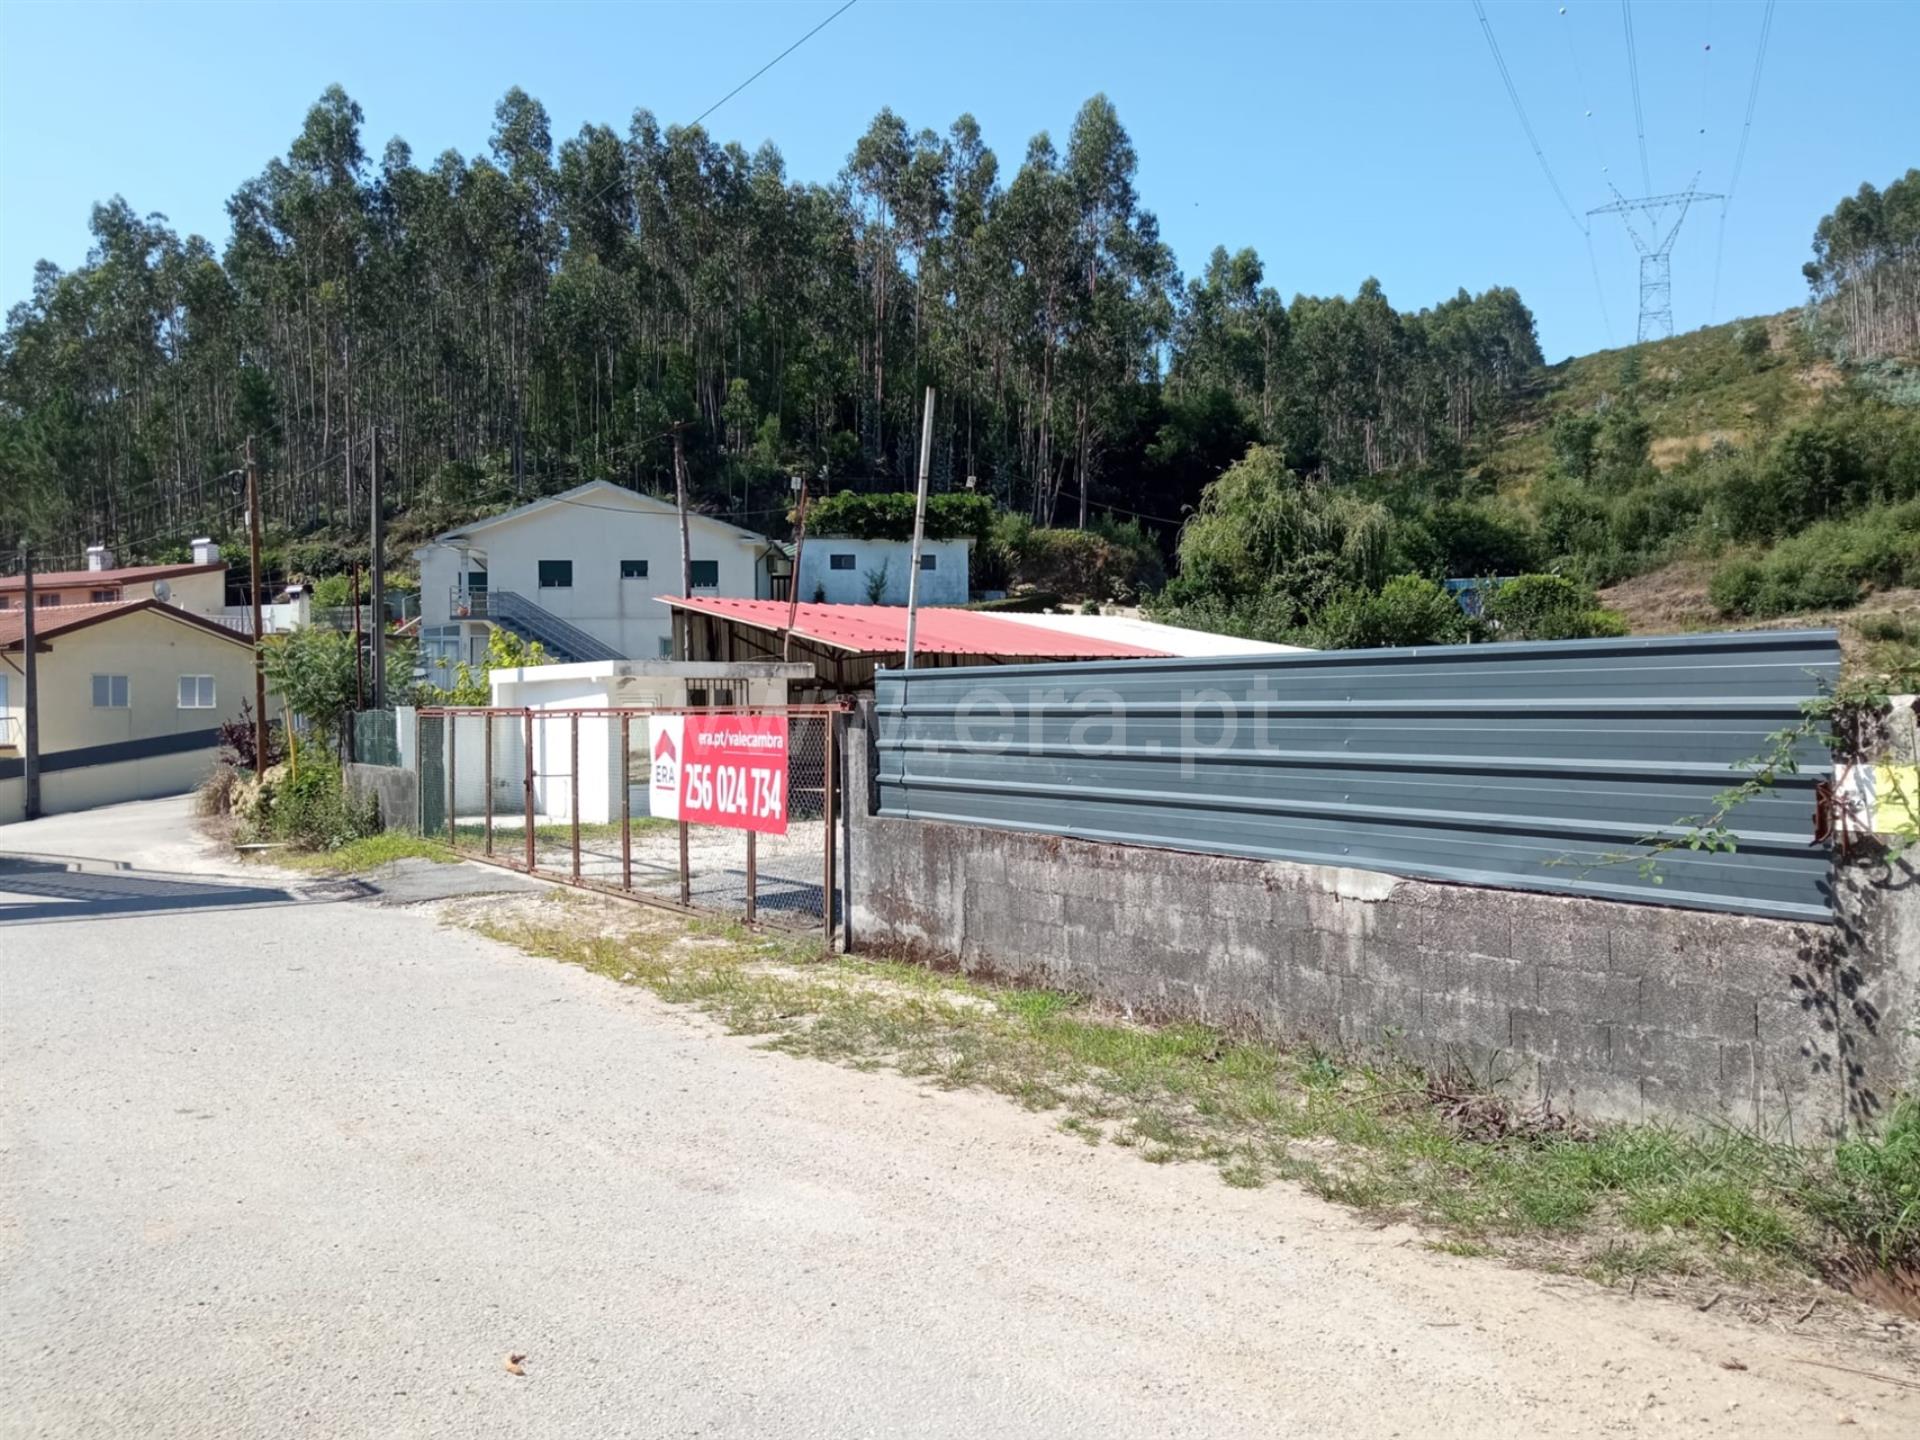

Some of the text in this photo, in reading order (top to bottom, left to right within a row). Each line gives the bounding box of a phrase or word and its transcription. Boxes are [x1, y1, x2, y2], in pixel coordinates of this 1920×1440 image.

[698, 729, 784, 749] era.pt/valecambra
[656, 765, 675, 784] ERA
[685, 763, 782, 820] 256 024 734
